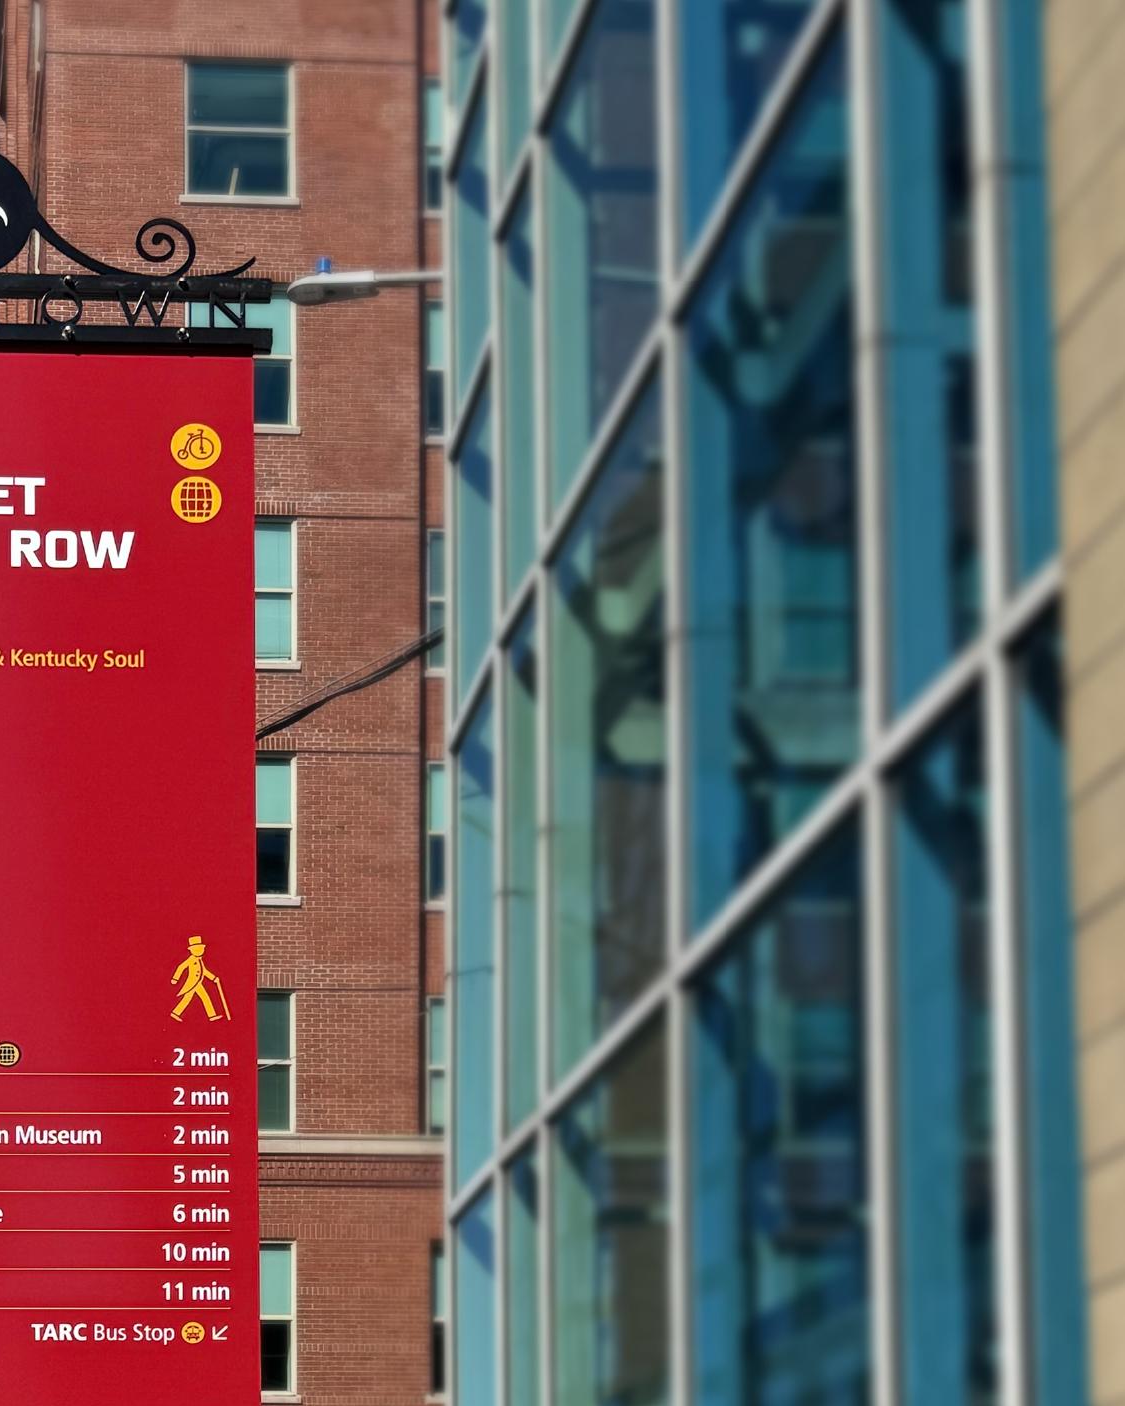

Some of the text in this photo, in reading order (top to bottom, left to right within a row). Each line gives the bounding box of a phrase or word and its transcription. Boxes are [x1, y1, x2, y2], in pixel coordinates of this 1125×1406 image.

[10, 529, 135, 569] ROW
[10, 648, 98, 672] Kentucky
[103, 649, 144, 668] Soul
[172, 1047, 229, 1067] 2 min
[172, 1086, 229, 1106] 2 min
[15, 1125, 102, 1145] Museum
[173, 1124, 229, 1145] 2 min
[173, 1163, 230, 1184] 5 min
[172, 1203, 230, 1223] 6 min
[161, 1241, 230, 1262] 10 min
[162, 1280, 230, 1301] 11 min
[30, 1322, 175, 1346] TARC Bus Stop
